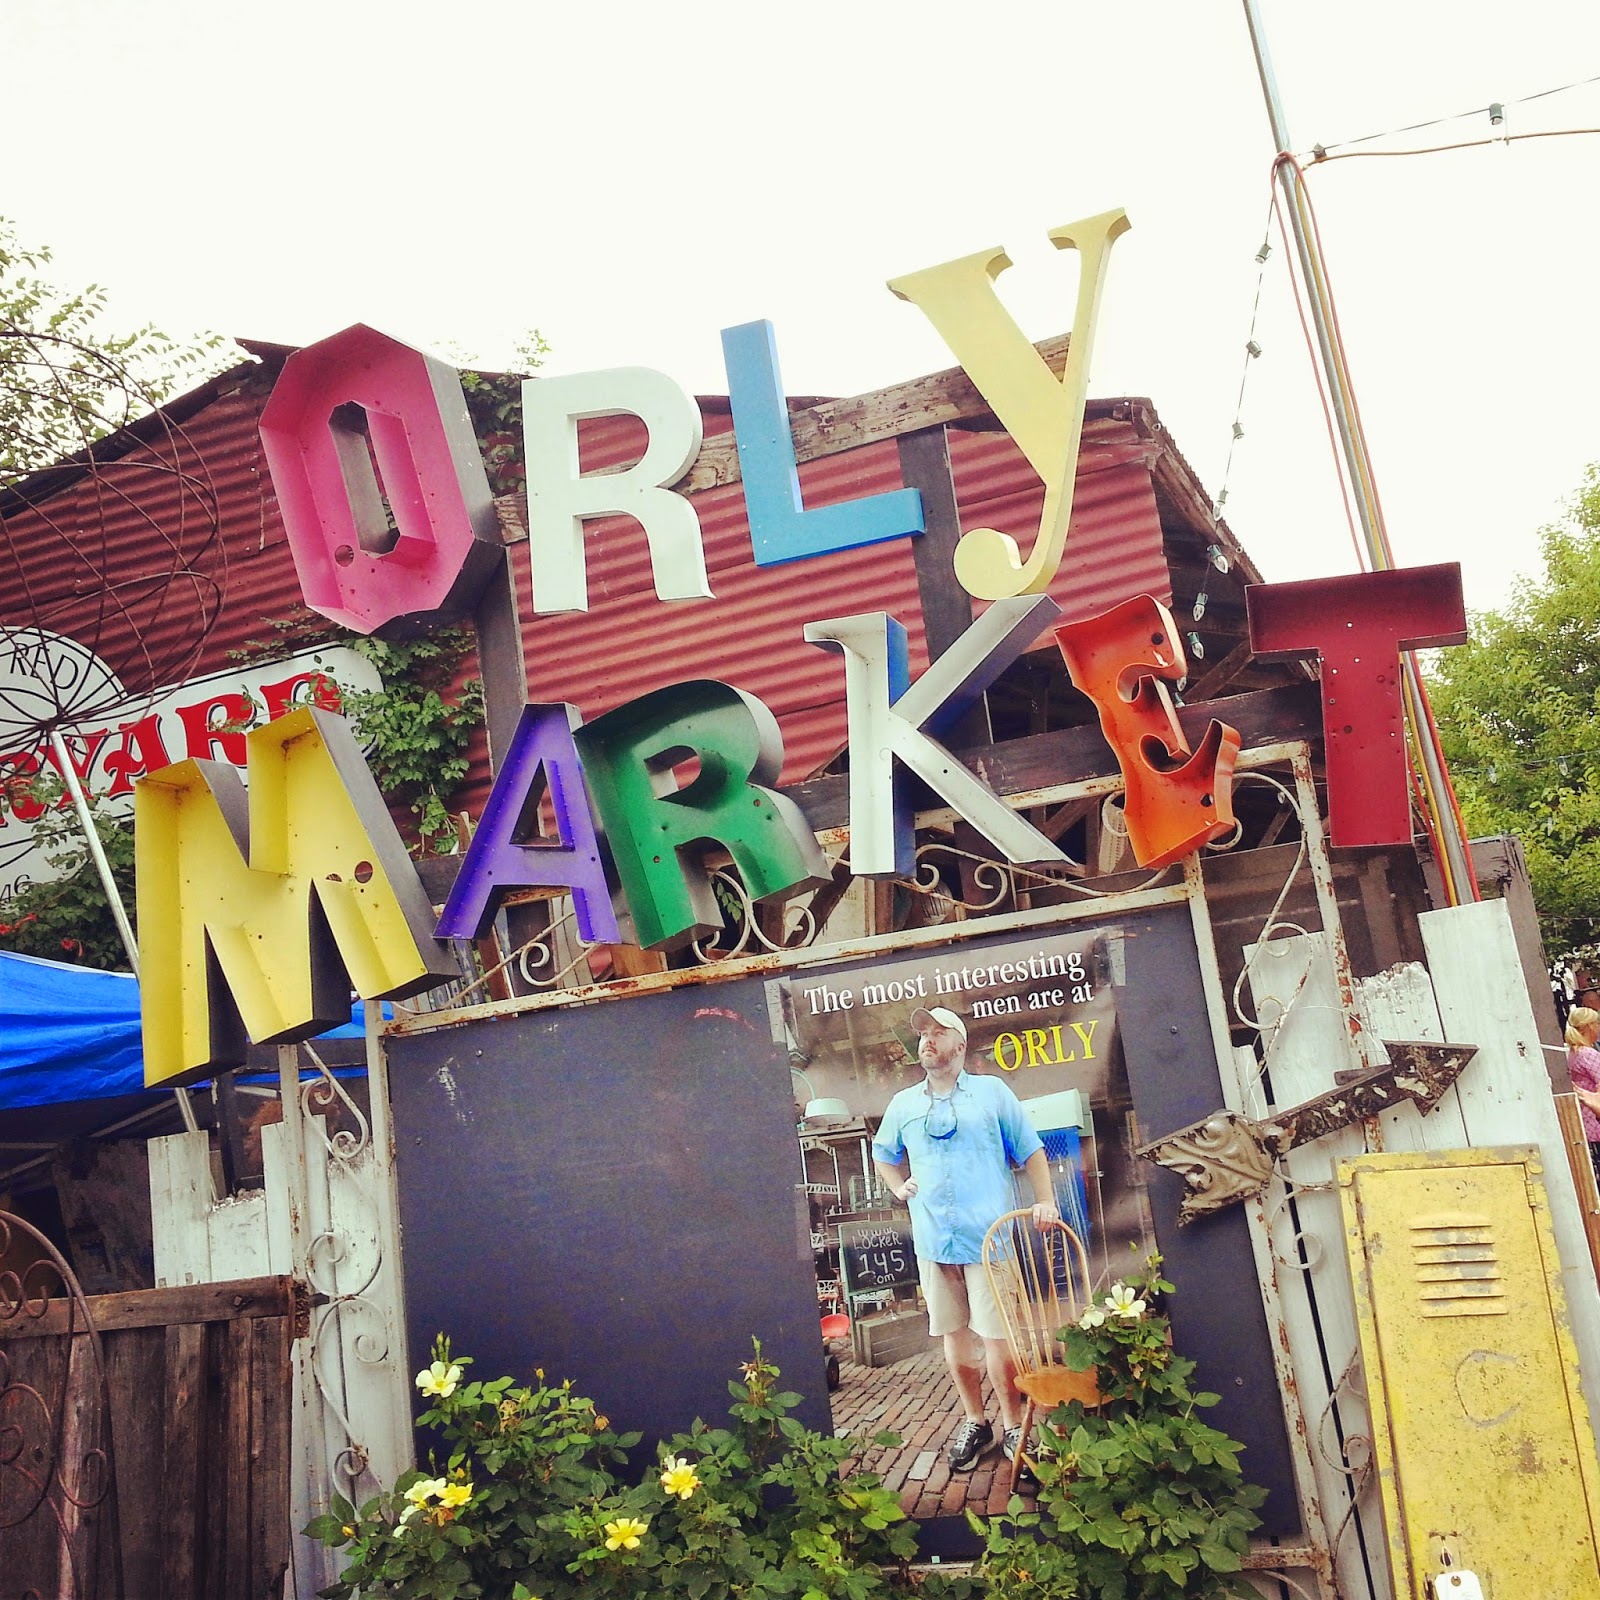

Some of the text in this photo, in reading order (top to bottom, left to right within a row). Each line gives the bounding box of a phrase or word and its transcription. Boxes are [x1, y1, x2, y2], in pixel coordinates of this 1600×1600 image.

[258, 207, 1132, 635] ORLY
[134, 562, 1467, 1088] MARKET
[803, 951, 1086, 1015] The most interesting
[971, 981, 1095, 1019] men are at
[994, 1020, 1099, 1072] ORLY
[858, 1249, 905, 1278] 145
